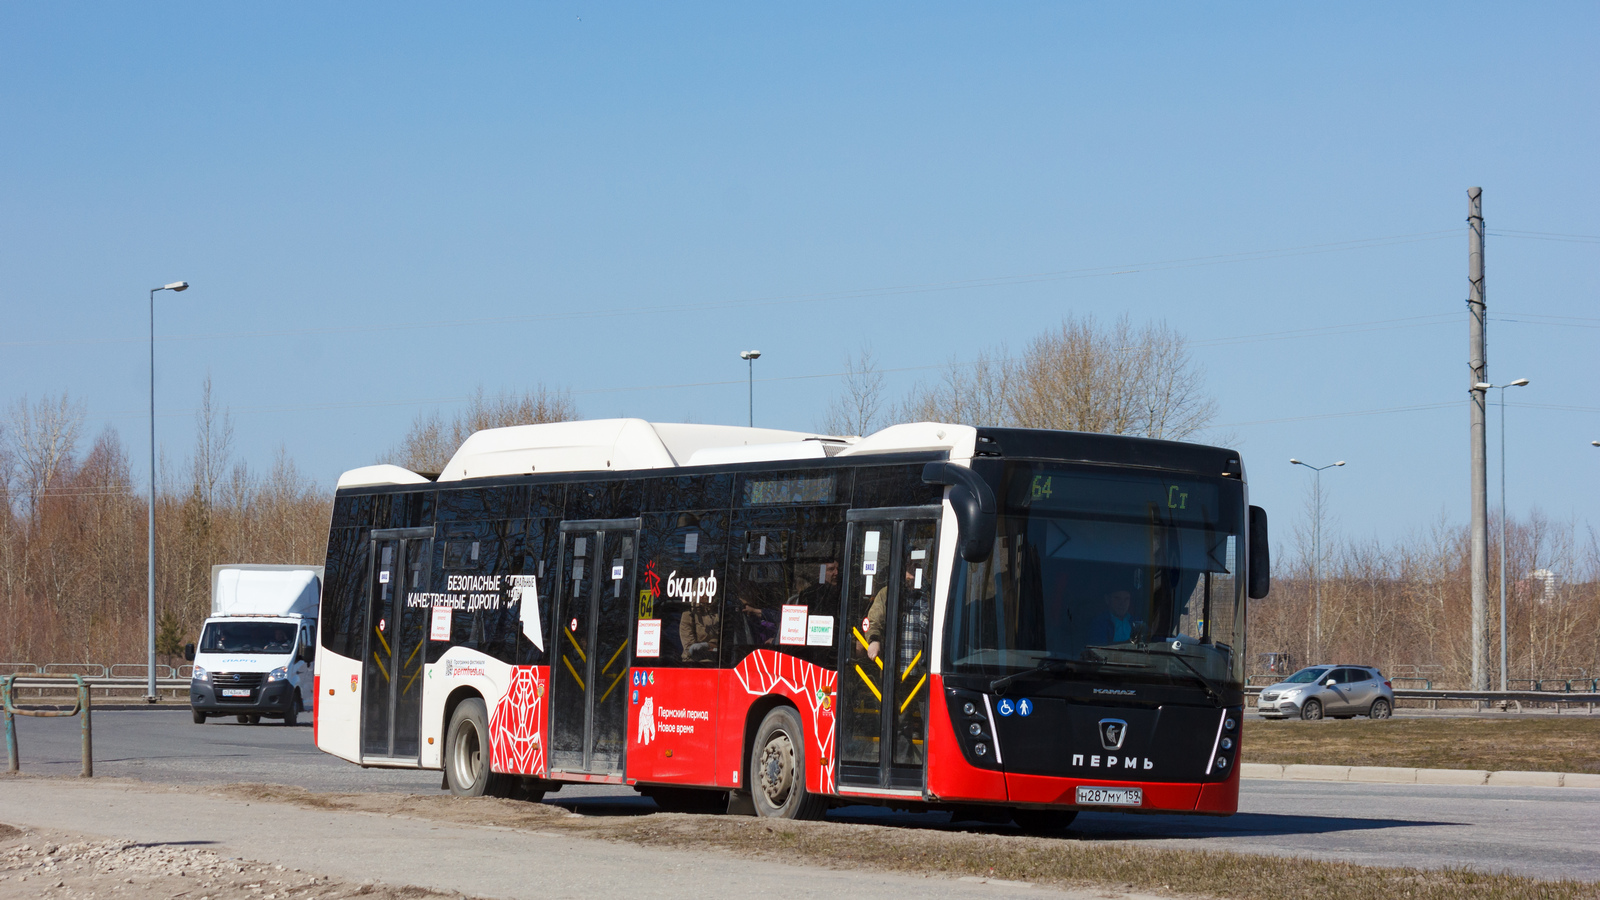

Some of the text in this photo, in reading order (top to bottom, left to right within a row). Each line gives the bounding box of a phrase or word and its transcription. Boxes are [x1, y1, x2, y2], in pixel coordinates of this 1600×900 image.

[1031, 475, 1052, 499] 64
[447, 575, 501, 591] БЕЗОПАСНЫЕ
[667, 569, 717, 603] бкд.рф
[407, 592, 466, 610] КАЧЕСТВЕННЫЕ
[467, 594, 500, 613] ДОРОГИ
[640, 596, 653, 618] 64
[1093, 688, 1137, 696] KAMAZ
[658, 706, 709, 721] Пермский период
[657, 721, 694, 736] Новое время
[1072, 753, 1154, 770] ПЕРМЬ
[1080, 789, 1139, 802] Н287МУ 159
